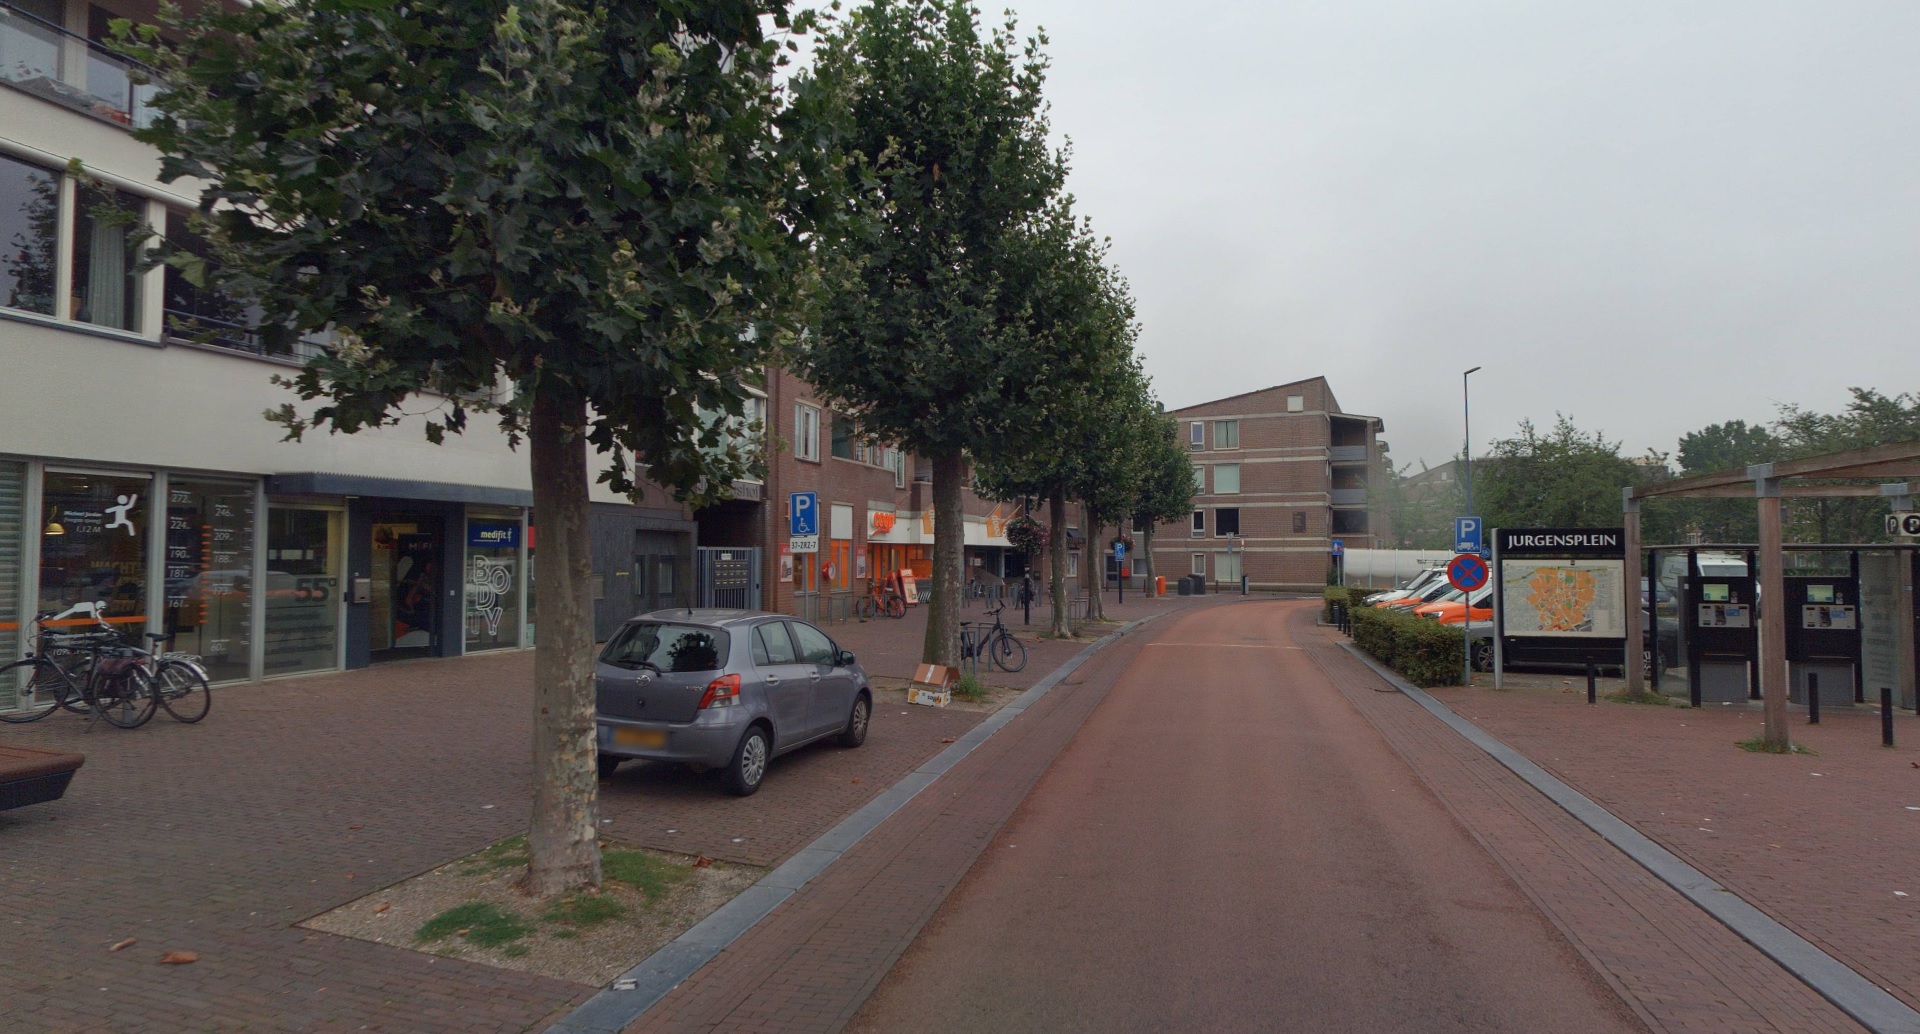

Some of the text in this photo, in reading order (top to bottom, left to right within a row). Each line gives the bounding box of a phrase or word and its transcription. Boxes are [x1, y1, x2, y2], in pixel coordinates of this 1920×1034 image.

[796, 496, 810, 517] P
[1461, 520, 1476, 539] P
[791, 541, 817, 549] 37-ZRZ-7
[1508, 534, 1616, 549] JURGENSPLEIN
